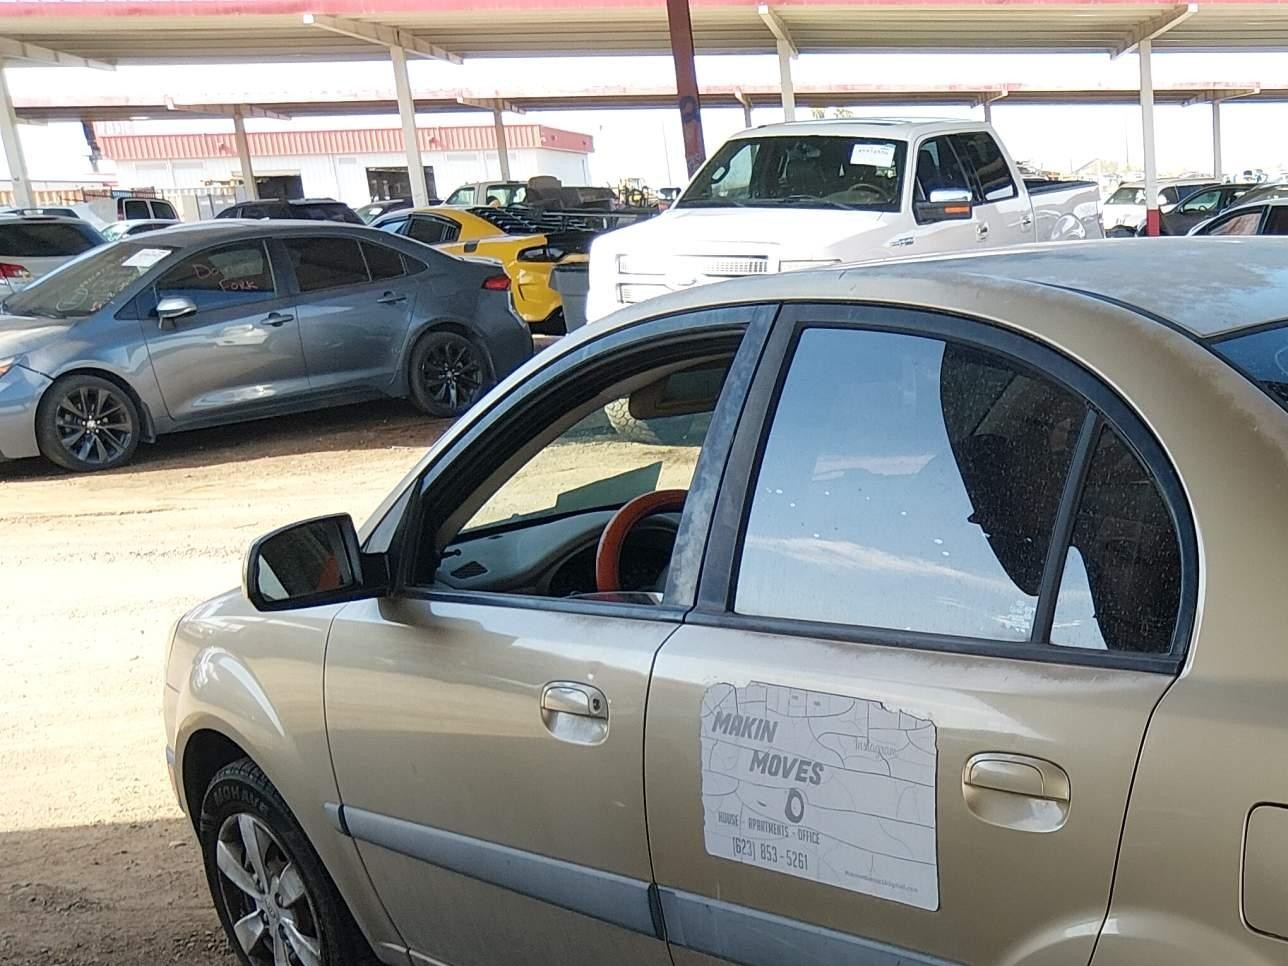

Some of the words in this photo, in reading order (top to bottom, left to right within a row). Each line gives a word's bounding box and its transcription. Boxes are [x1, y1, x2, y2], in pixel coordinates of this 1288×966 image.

[711, 711, 778, 743] MAKIN
[749, 750, 825, 786] MOVES
[718, 811, 739, 827] HOUSE
[748, 817, 789, 838] APARTMENTS
[797, 828, 820, 845] OFFICE
[732, 836, 756, 861] (623)
